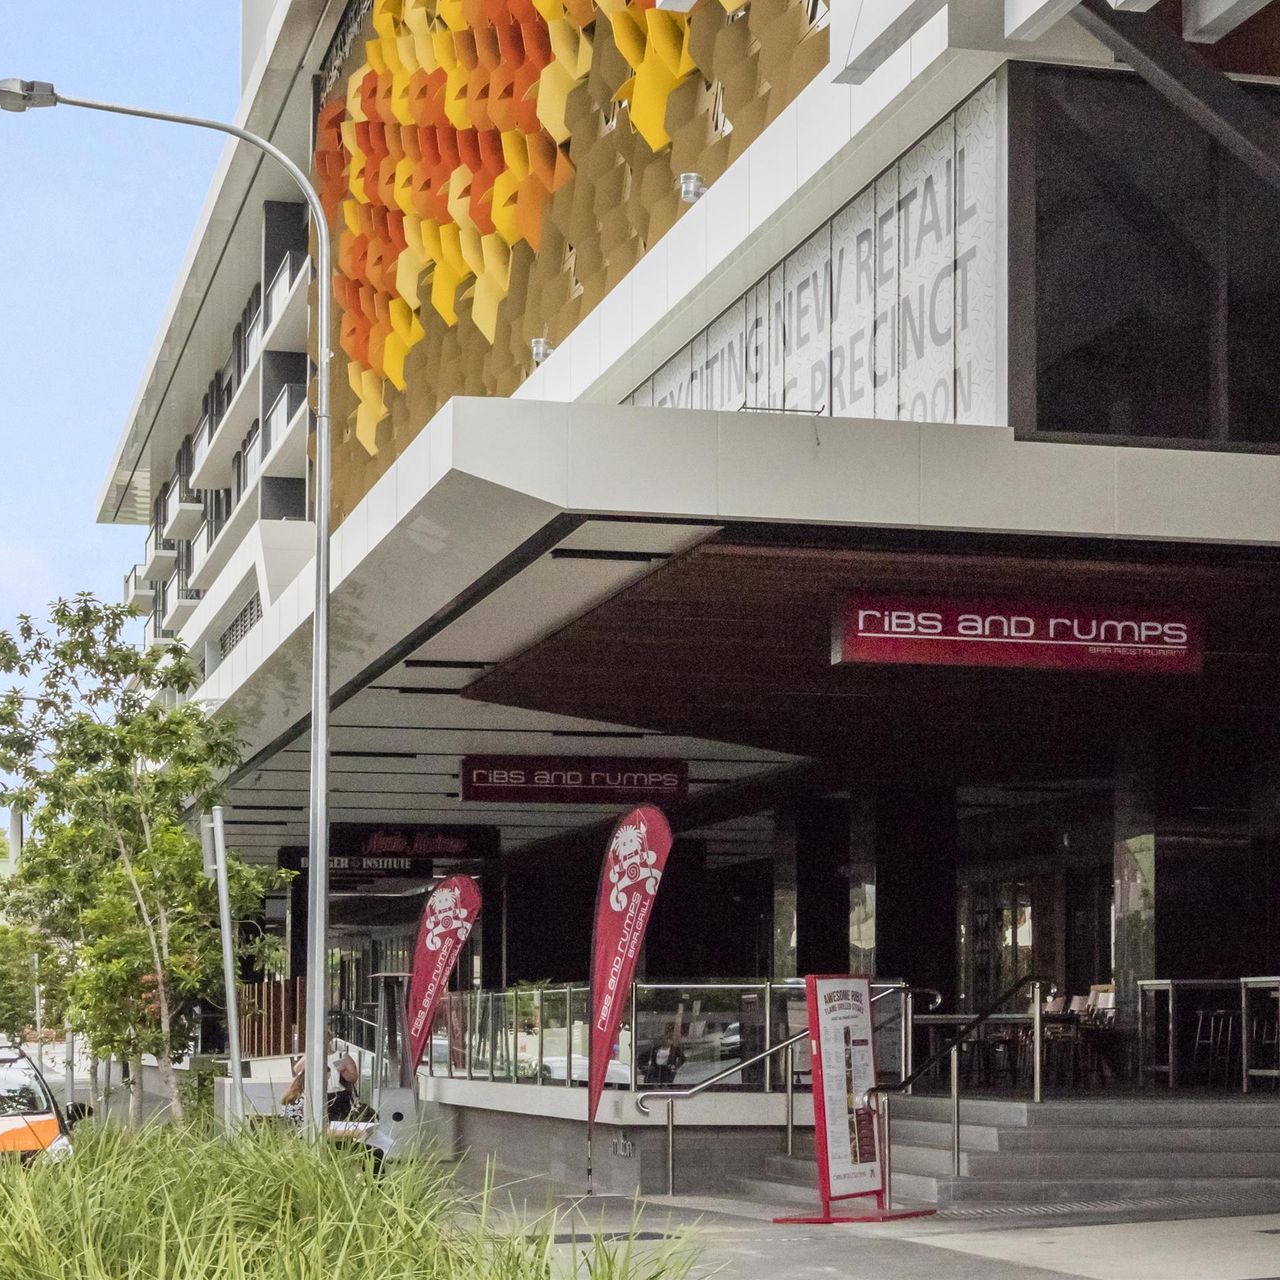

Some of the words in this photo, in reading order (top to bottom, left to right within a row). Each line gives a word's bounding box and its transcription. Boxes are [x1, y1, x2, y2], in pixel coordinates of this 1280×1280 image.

[658, 316, 763, 410] XCITING
[774, 247, 844, 367] NEW
[856, 147, 977, 304] RETAIL
[810, 244, 977, 412] PRECINCT
[300, 857, 349, 869] BGER
[362, 857, 412, 869] INSTITUTE
